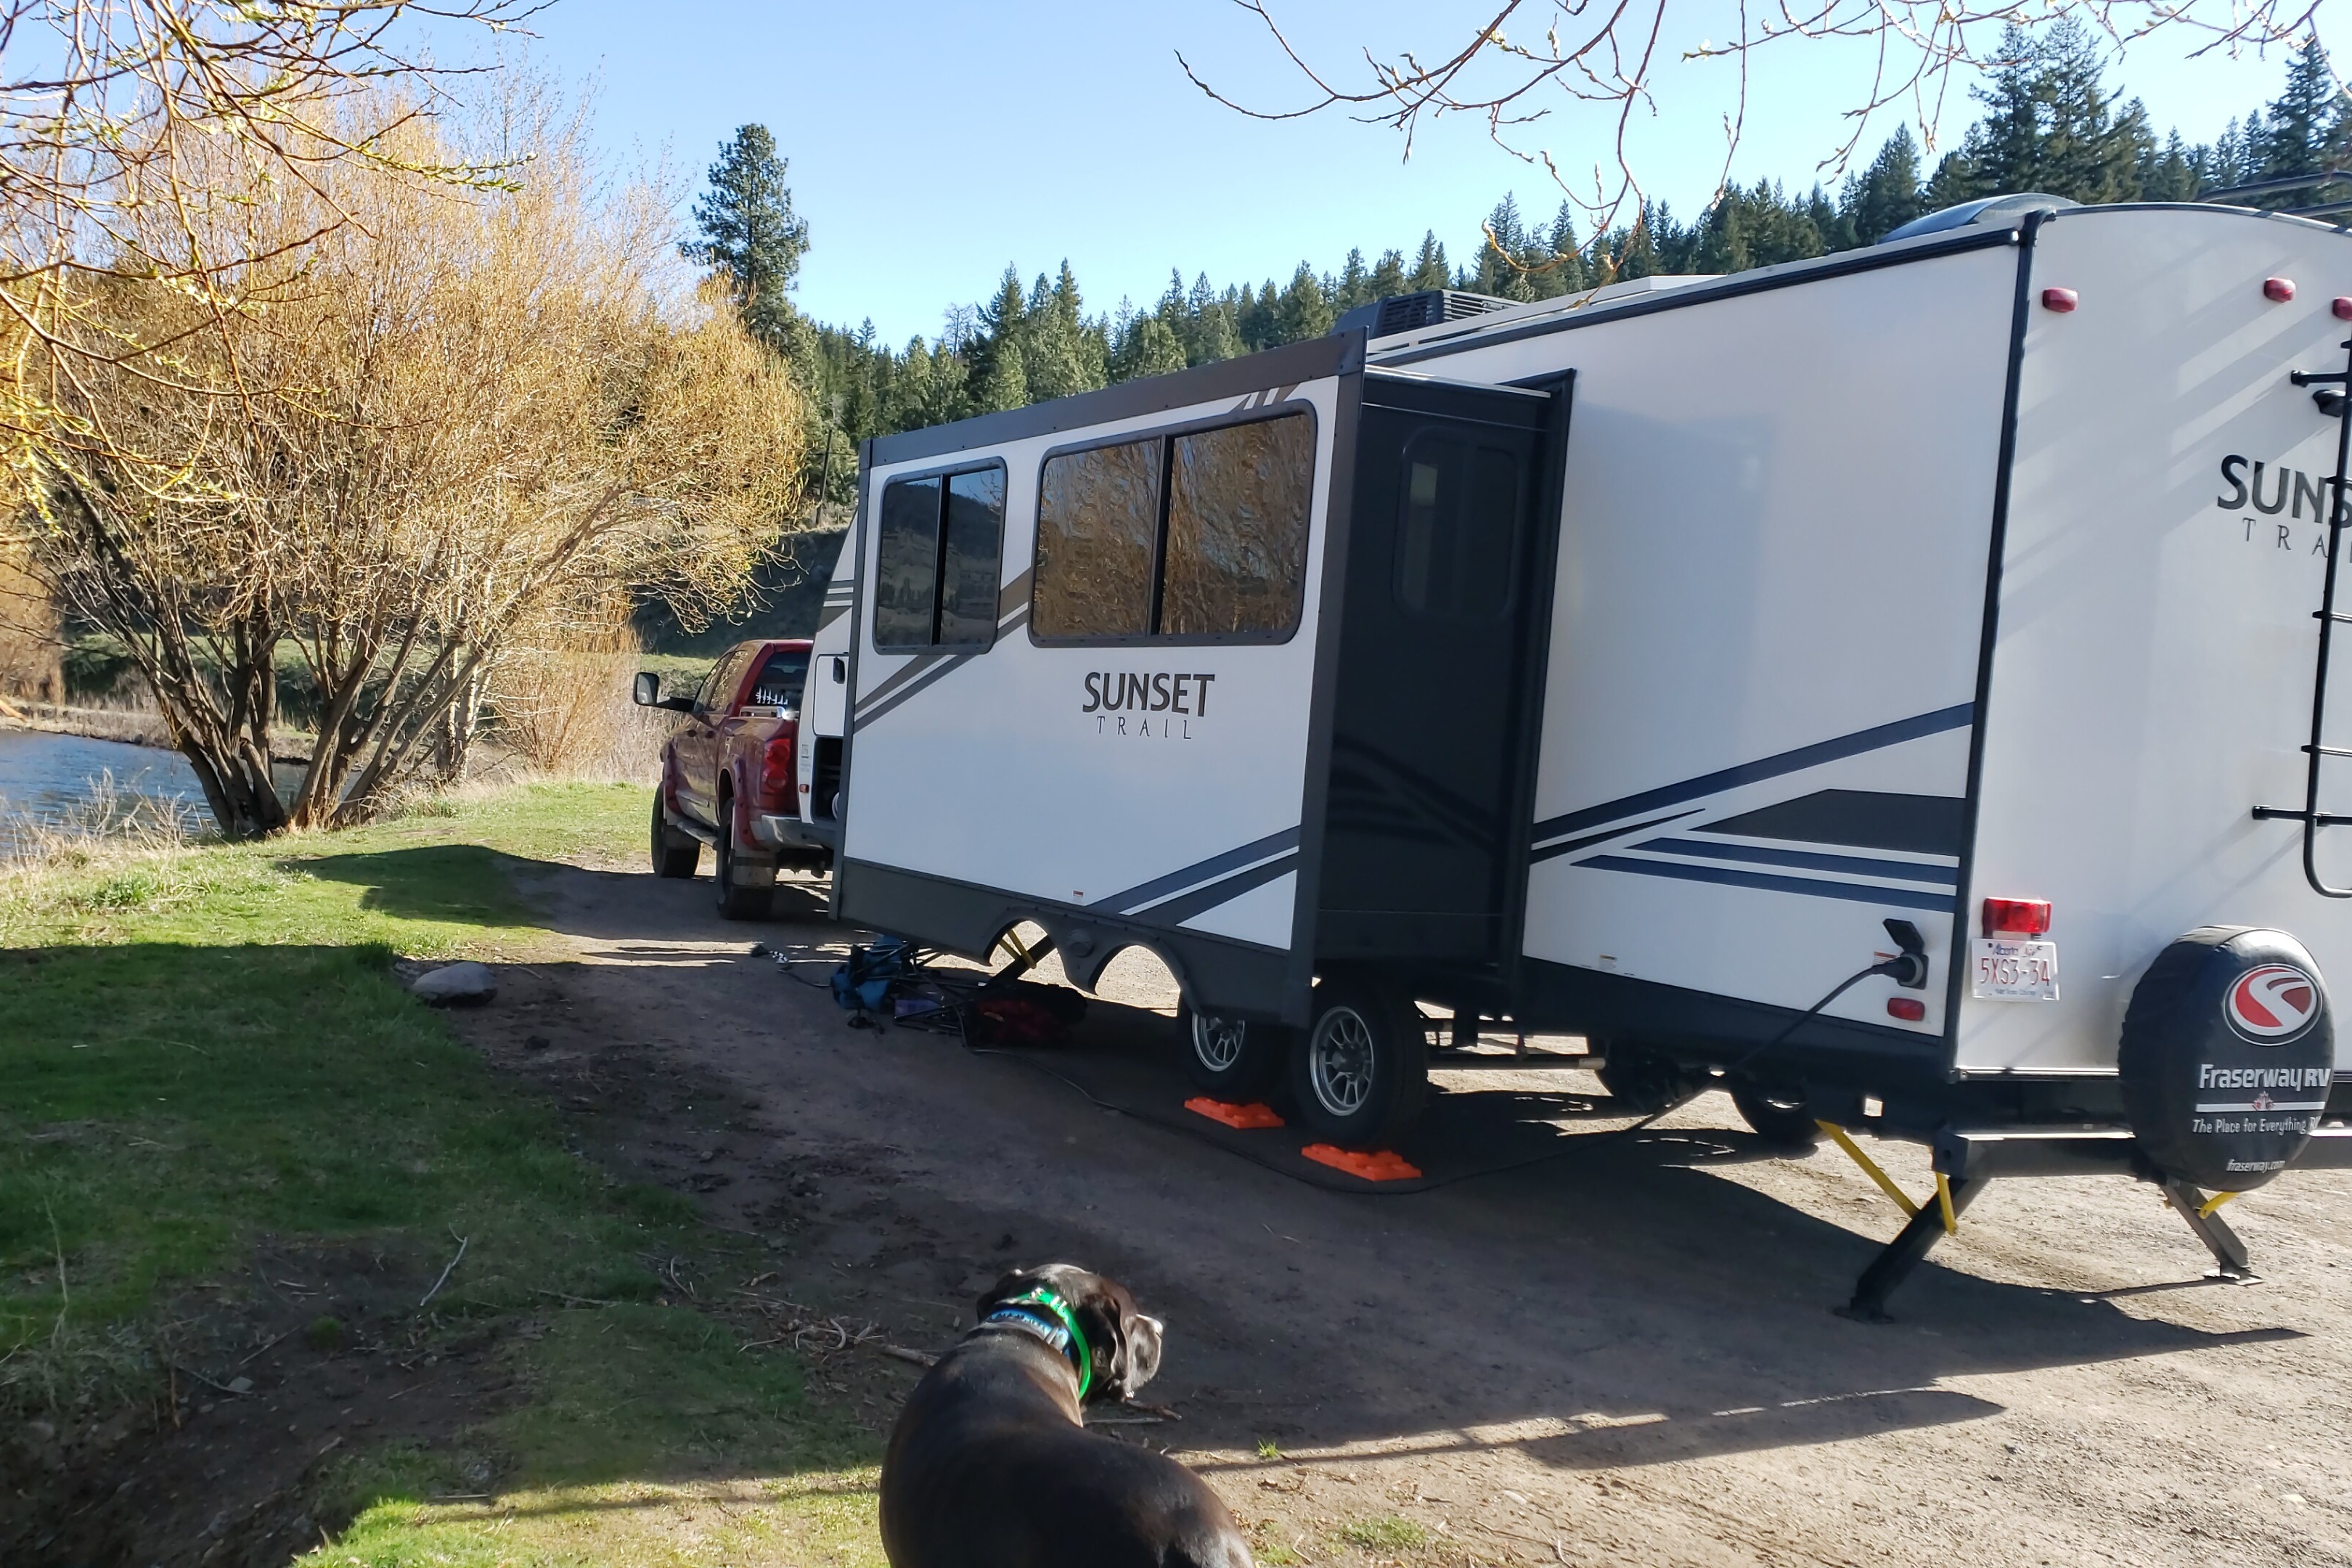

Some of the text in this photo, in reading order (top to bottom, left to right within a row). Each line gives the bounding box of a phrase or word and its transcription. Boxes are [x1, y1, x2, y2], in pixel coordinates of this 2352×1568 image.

[1082, 672, 1215, 717] SUNSET
[1097, 716, 1191, 740] TRAIL
[2192, 1119, 2213, 1133] The
[2216, 1118, 2240, 1133] Place
[2244, 1117, 2257, 1132] for
[2260, 1116, 2306, 1135] Everything
